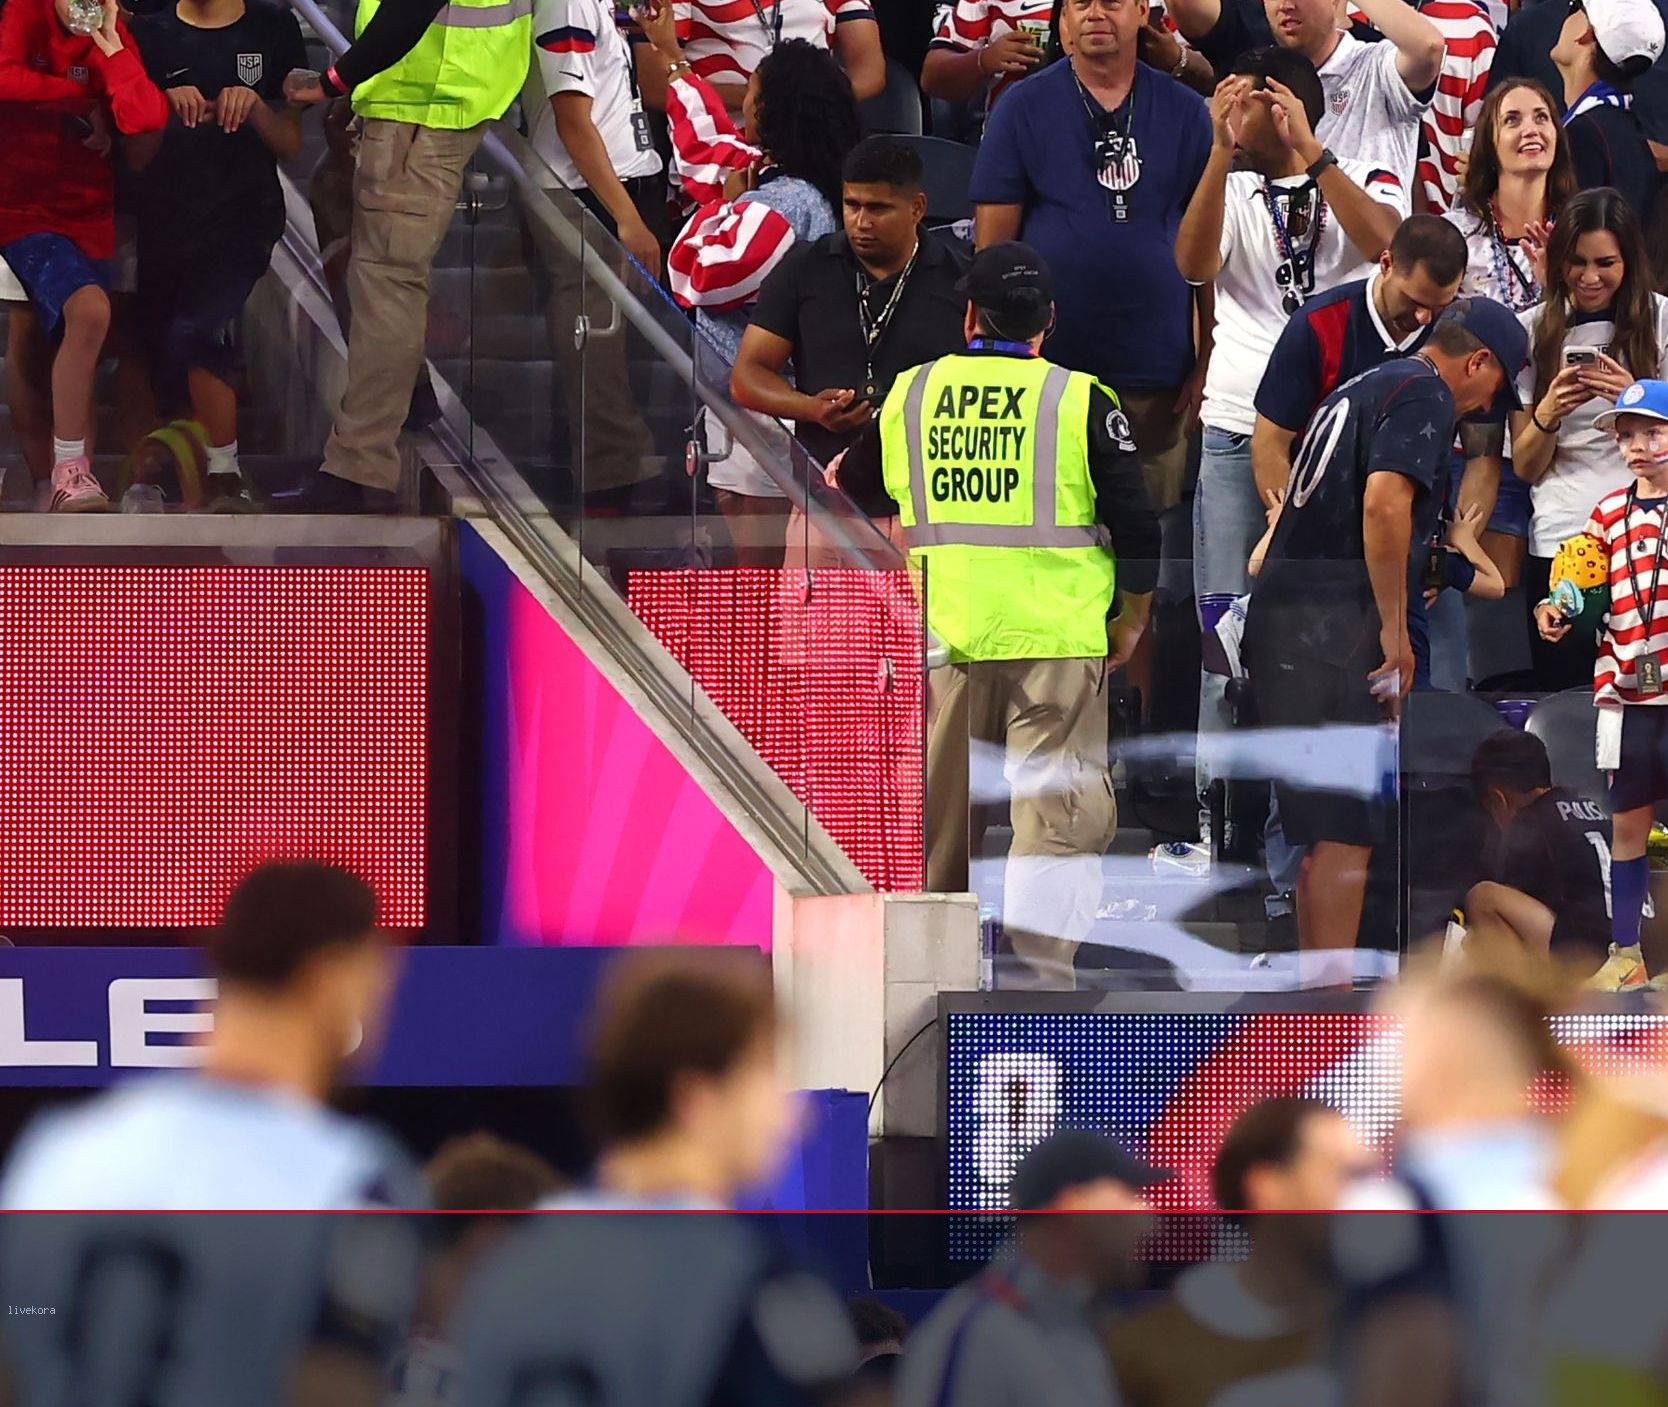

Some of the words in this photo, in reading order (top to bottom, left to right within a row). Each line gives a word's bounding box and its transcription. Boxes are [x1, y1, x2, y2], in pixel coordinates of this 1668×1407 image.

[934, 385, 1026, 420] APEX
[927, 424, 1026, 462] SECURITY
[931, 467, 1020, 504] GROUP
[1555, 800, 1608, 822] PULIS
